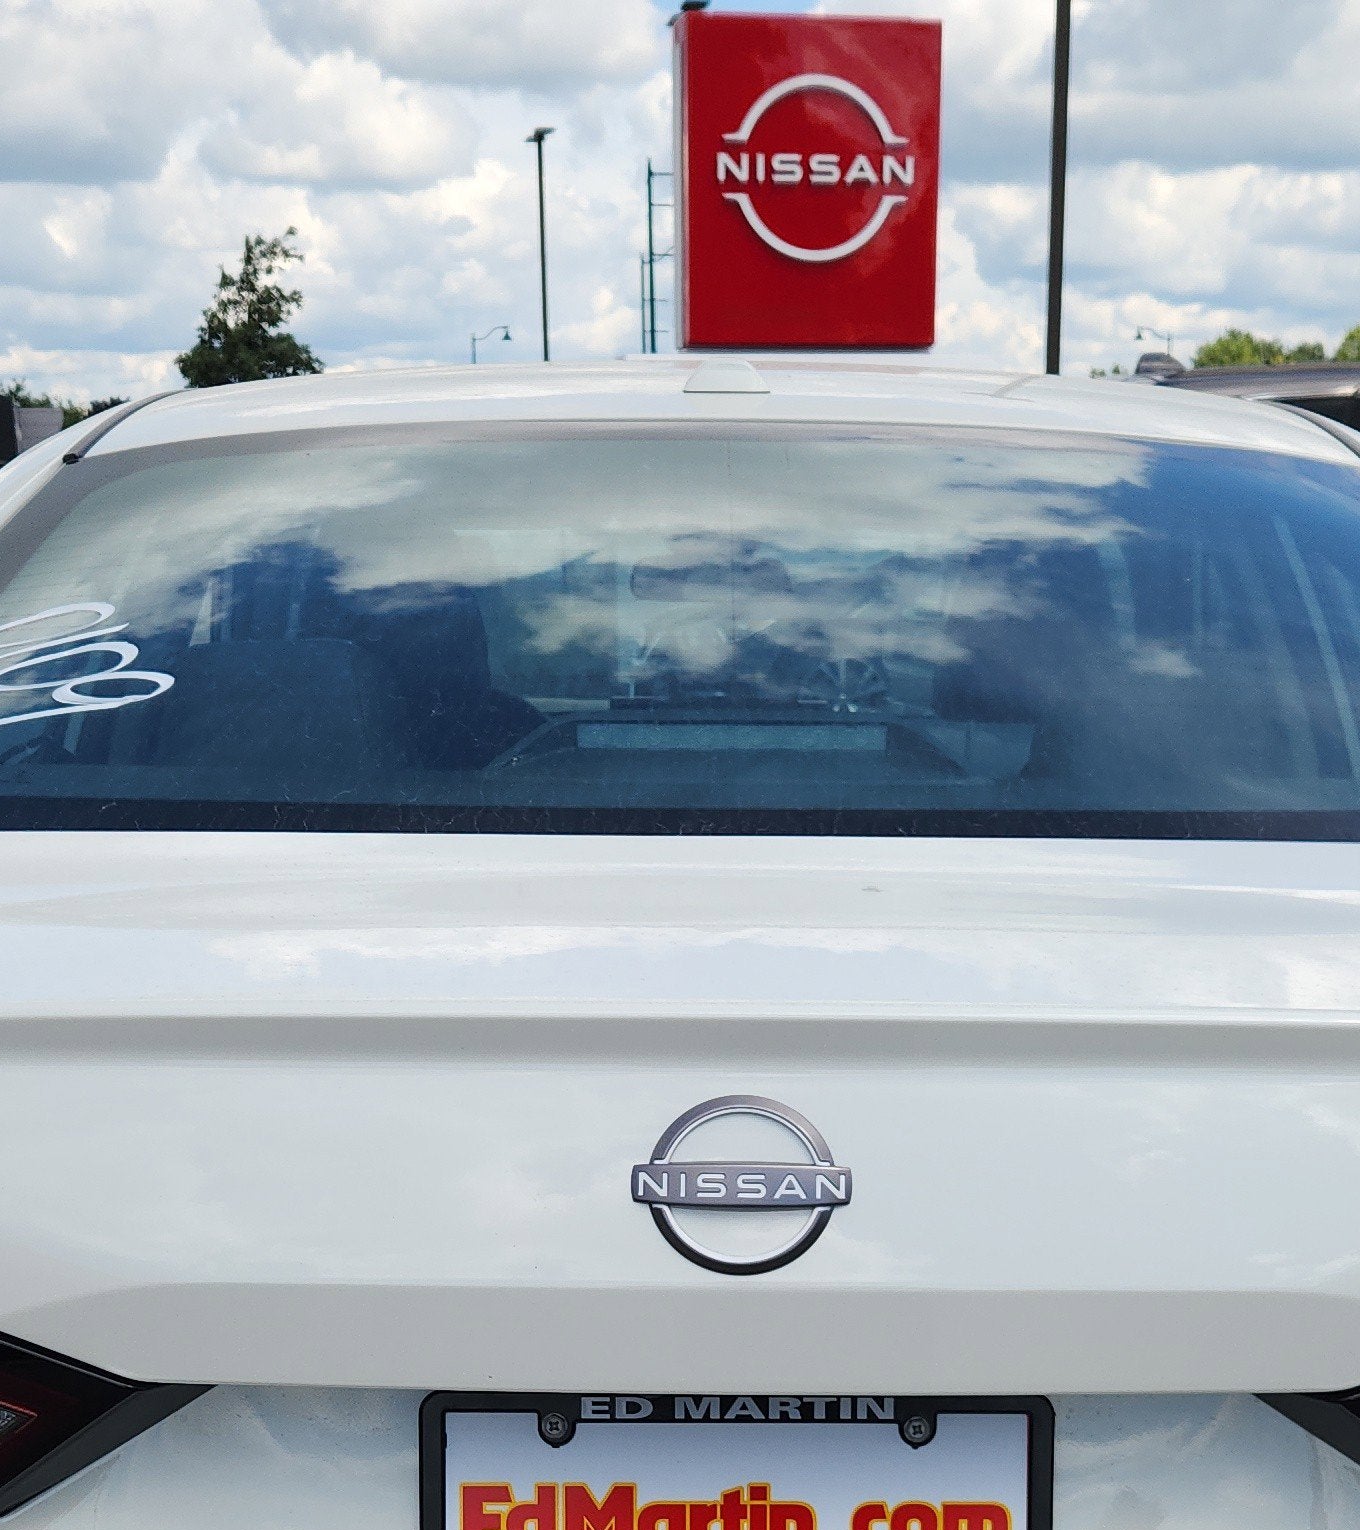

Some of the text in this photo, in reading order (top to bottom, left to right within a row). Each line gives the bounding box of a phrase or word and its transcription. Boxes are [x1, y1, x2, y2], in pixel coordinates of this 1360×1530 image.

[716, 151, 916, 187] NISSAN
[637, 1171, 847, 1200] NISSAN
[580, 1397, 895, 1421] ED MARTIN
